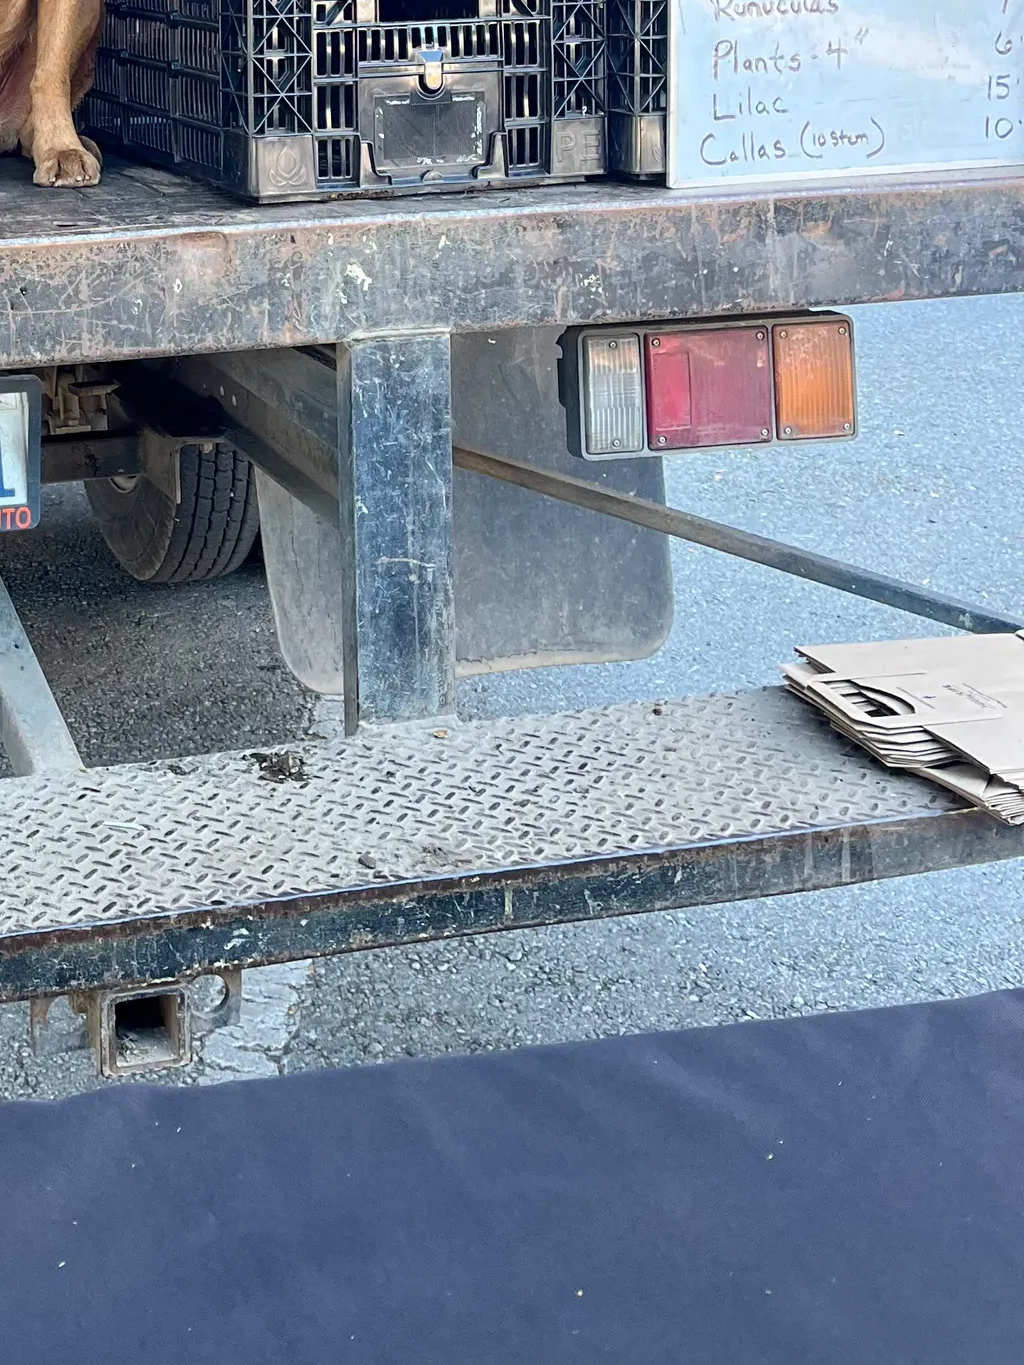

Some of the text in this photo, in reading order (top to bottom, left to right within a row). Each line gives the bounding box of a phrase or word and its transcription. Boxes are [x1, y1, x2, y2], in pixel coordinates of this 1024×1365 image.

[713, 39, 802, 80] Plants
[713, 86, 788, 121] Lilac
[556, 129, 600, 163] PE
[700, 131, 786, 165] Callas
